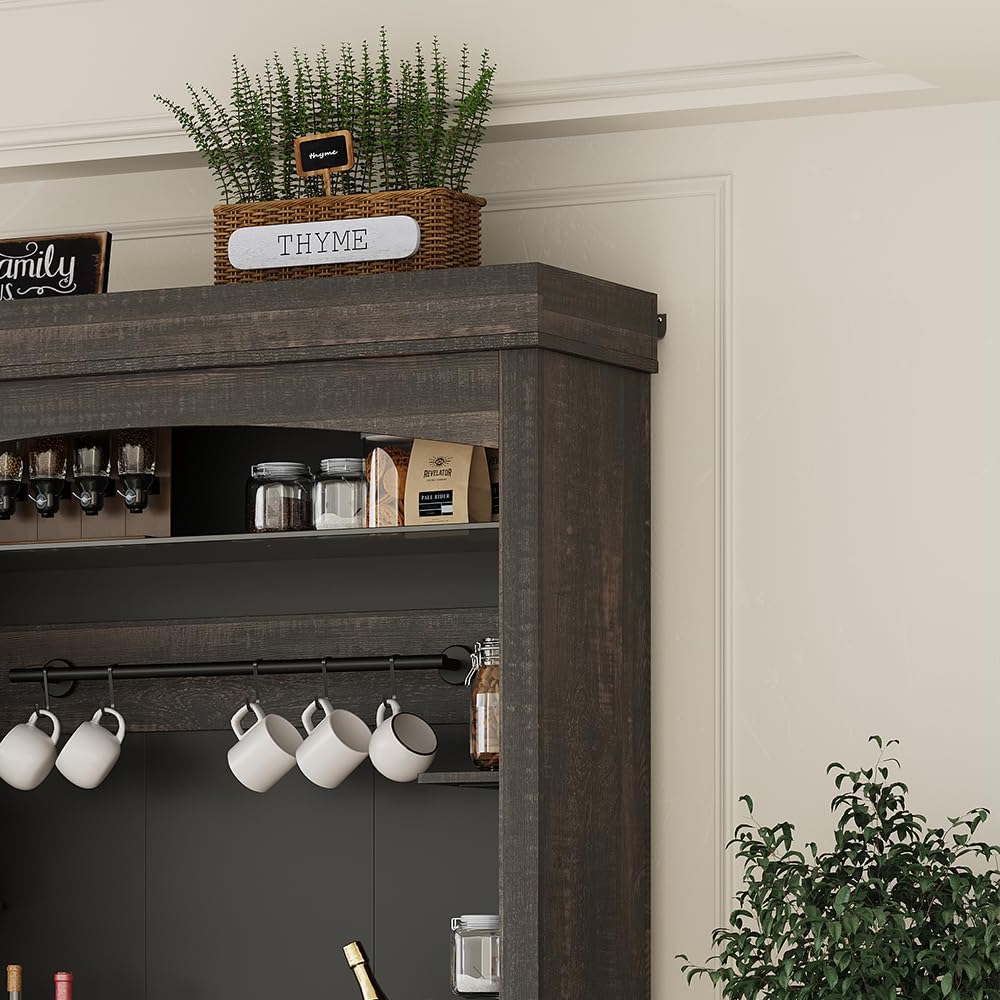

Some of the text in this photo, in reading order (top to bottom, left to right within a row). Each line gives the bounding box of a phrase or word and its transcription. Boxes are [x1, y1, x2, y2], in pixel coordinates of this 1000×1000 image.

[309, 150, 338, 159] thyme
[278, 228, 368, 256] THYME
[423, 468, 453, 479] REVELATOR
